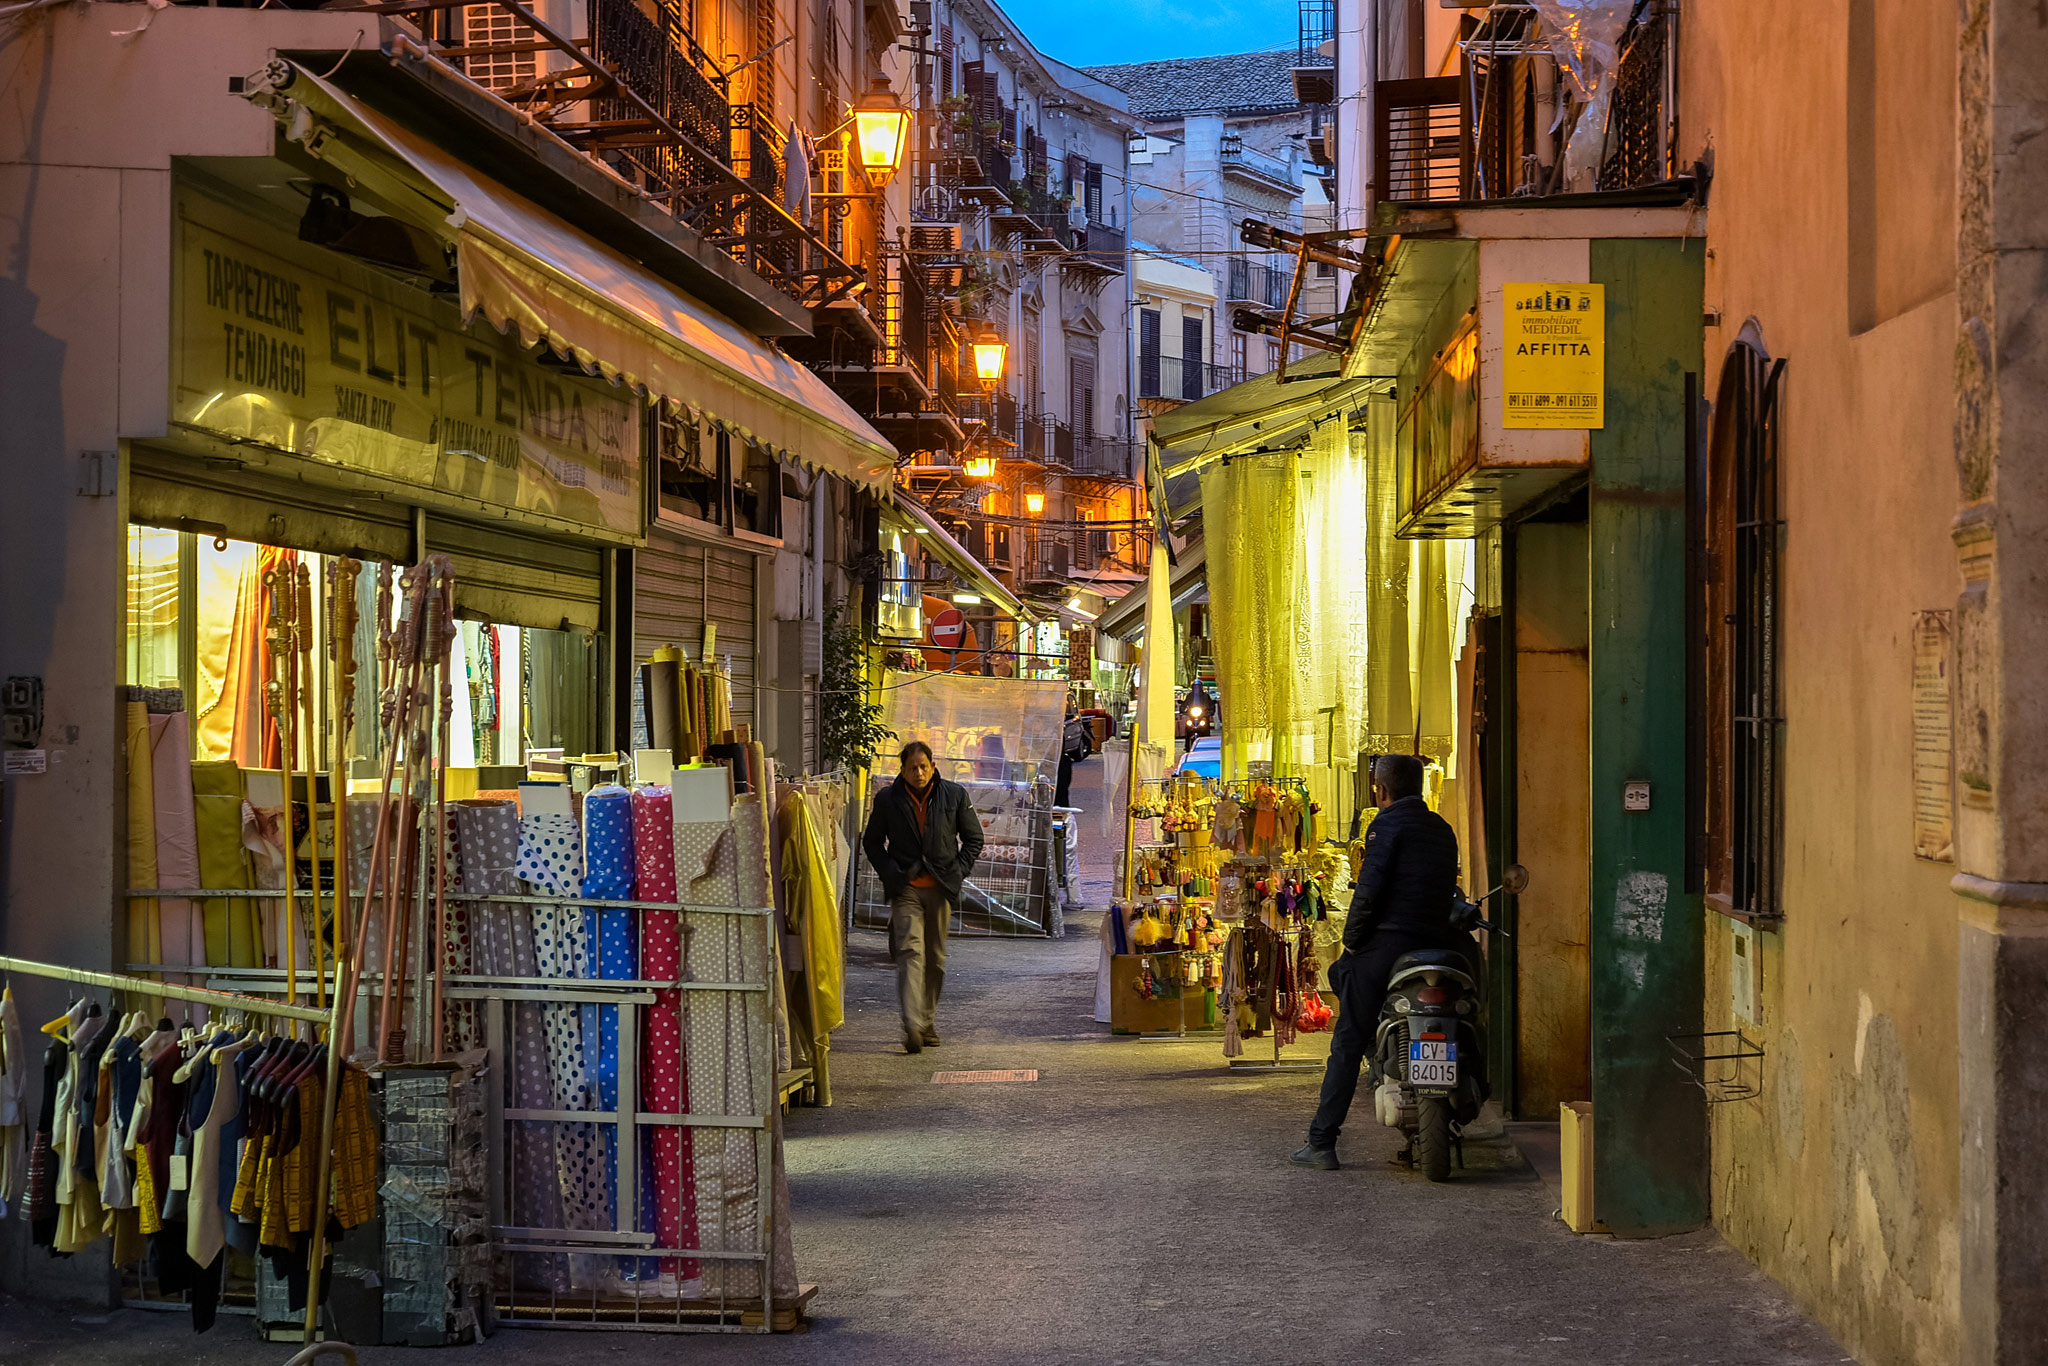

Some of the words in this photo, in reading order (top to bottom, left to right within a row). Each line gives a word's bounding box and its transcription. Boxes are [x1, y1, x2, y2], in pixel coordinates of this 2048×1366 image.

[203, 249, 304, 335] TAPPEZZERIE
[1522, 315, 1582, 325] immobiliare
[1522, 325, 1582, 334] MEDIEDIL
[1516, 343, 1591, 356] AFFITTA
[224, 322, 306, 398] TENDAGGI
[326, 289, 437, 396] ELIT
[465, 348, 588, 453] TENDA
[1508, 395, 1520, 406] 091
[1522, 395, 1533, 406] 611
[1556, 395, 1567, 407] 091
[1569, 395, 1580, 407] 611
[444, 417, 492, 459] TAMMARO
[495, 434, 520, 470] ALDO
[1421, 1043, 1438, 1059] CV
[1412, 1064, 1455, 1081] 84015
